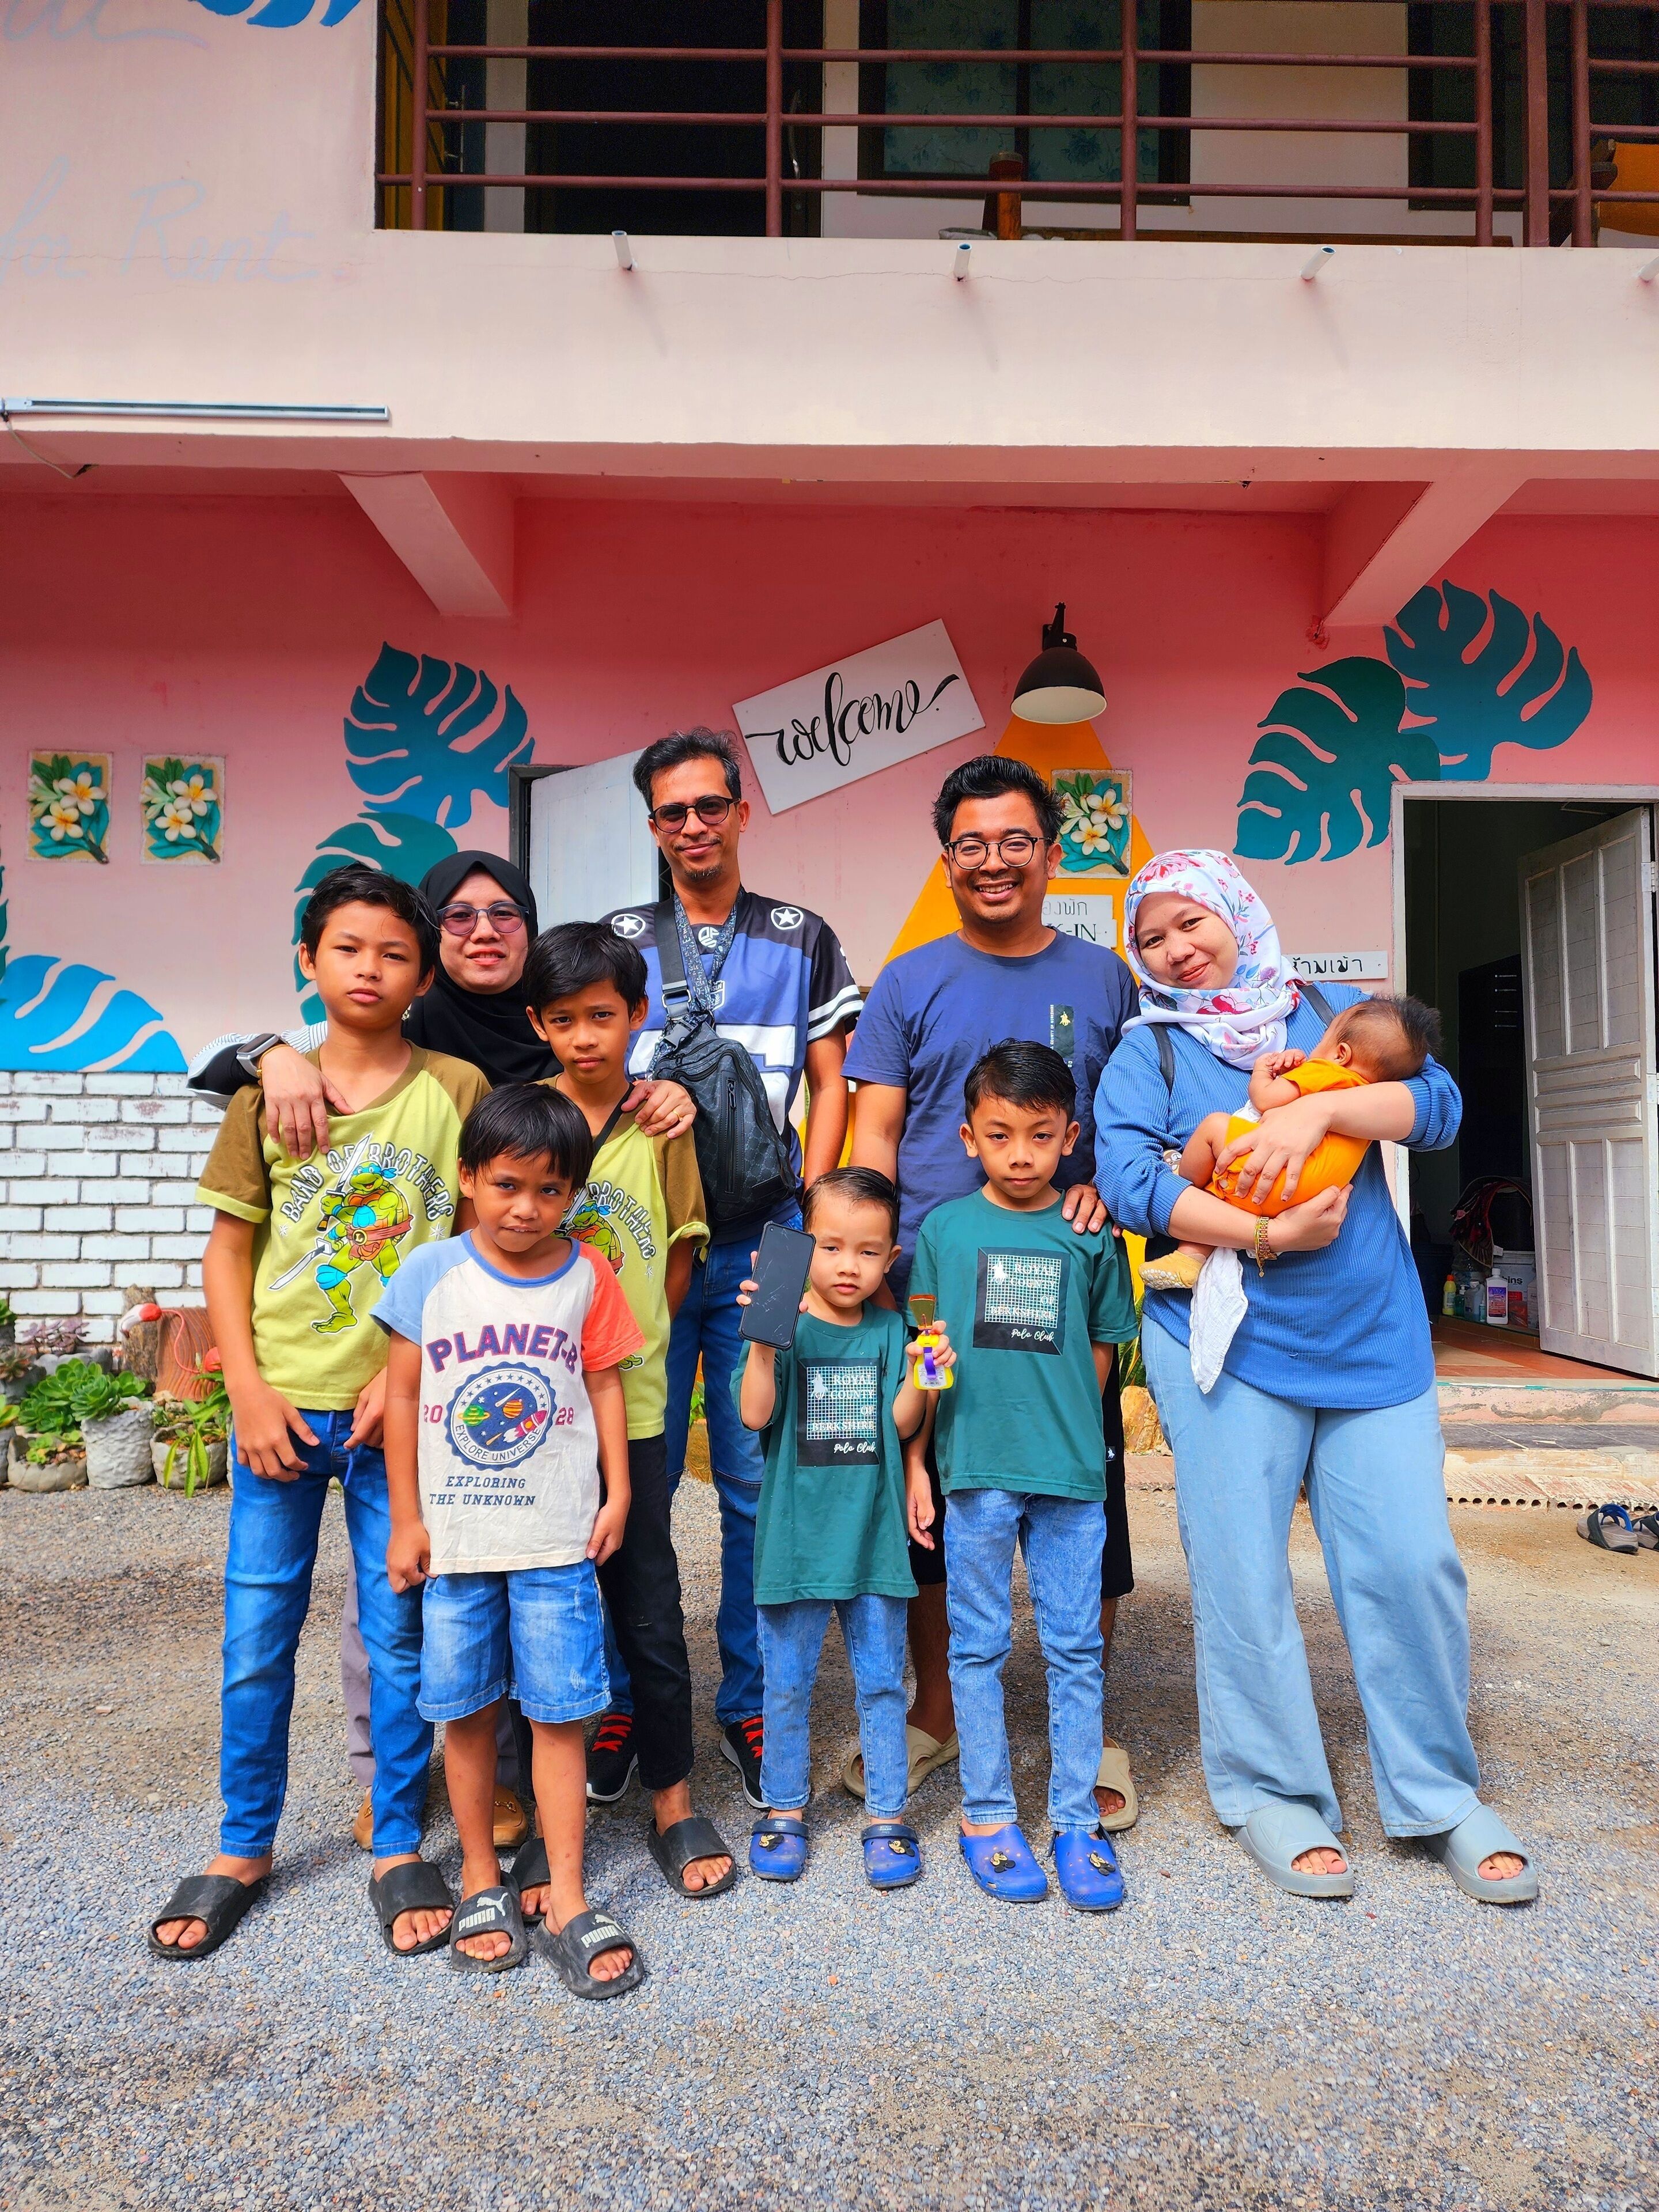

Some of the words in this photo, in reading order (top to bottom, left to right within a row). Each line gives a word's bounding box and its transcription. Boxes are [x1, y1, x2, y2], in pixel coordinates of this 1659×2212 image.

[1042, 898, 1088, 916] องพัก
[279, 1164, 324, 1224] BAND
[367, 1141, 455, 1222] BROTHERS
[1034, 1331, 1055, 1342] Club
[831, 1374, 875, 1385] ROYAL
[830, 1389, 875, 1400] COUNTY
[554, 1407, 574, 1426] 28
[860, 1406, 874, 1415] OF
[810, 1421, 875, 1432] BERKSHIRE
[455, 1423, 488, 1461] EXPLORE
[491, 1428, 541, 1462] UNIVERSE
[834, 1441, 855, 1454] Polo
[856, 1441, 876, 1453] Club
[445, 1475, 526, 1489] EXPLORING
[429, 1493, 456, 1505] THE
[463, 1494, 536, 1507] UNKNOWN
[459, 1907, 496, 1932] PUMA
[581, 1925, 620, 1948] PUMA
